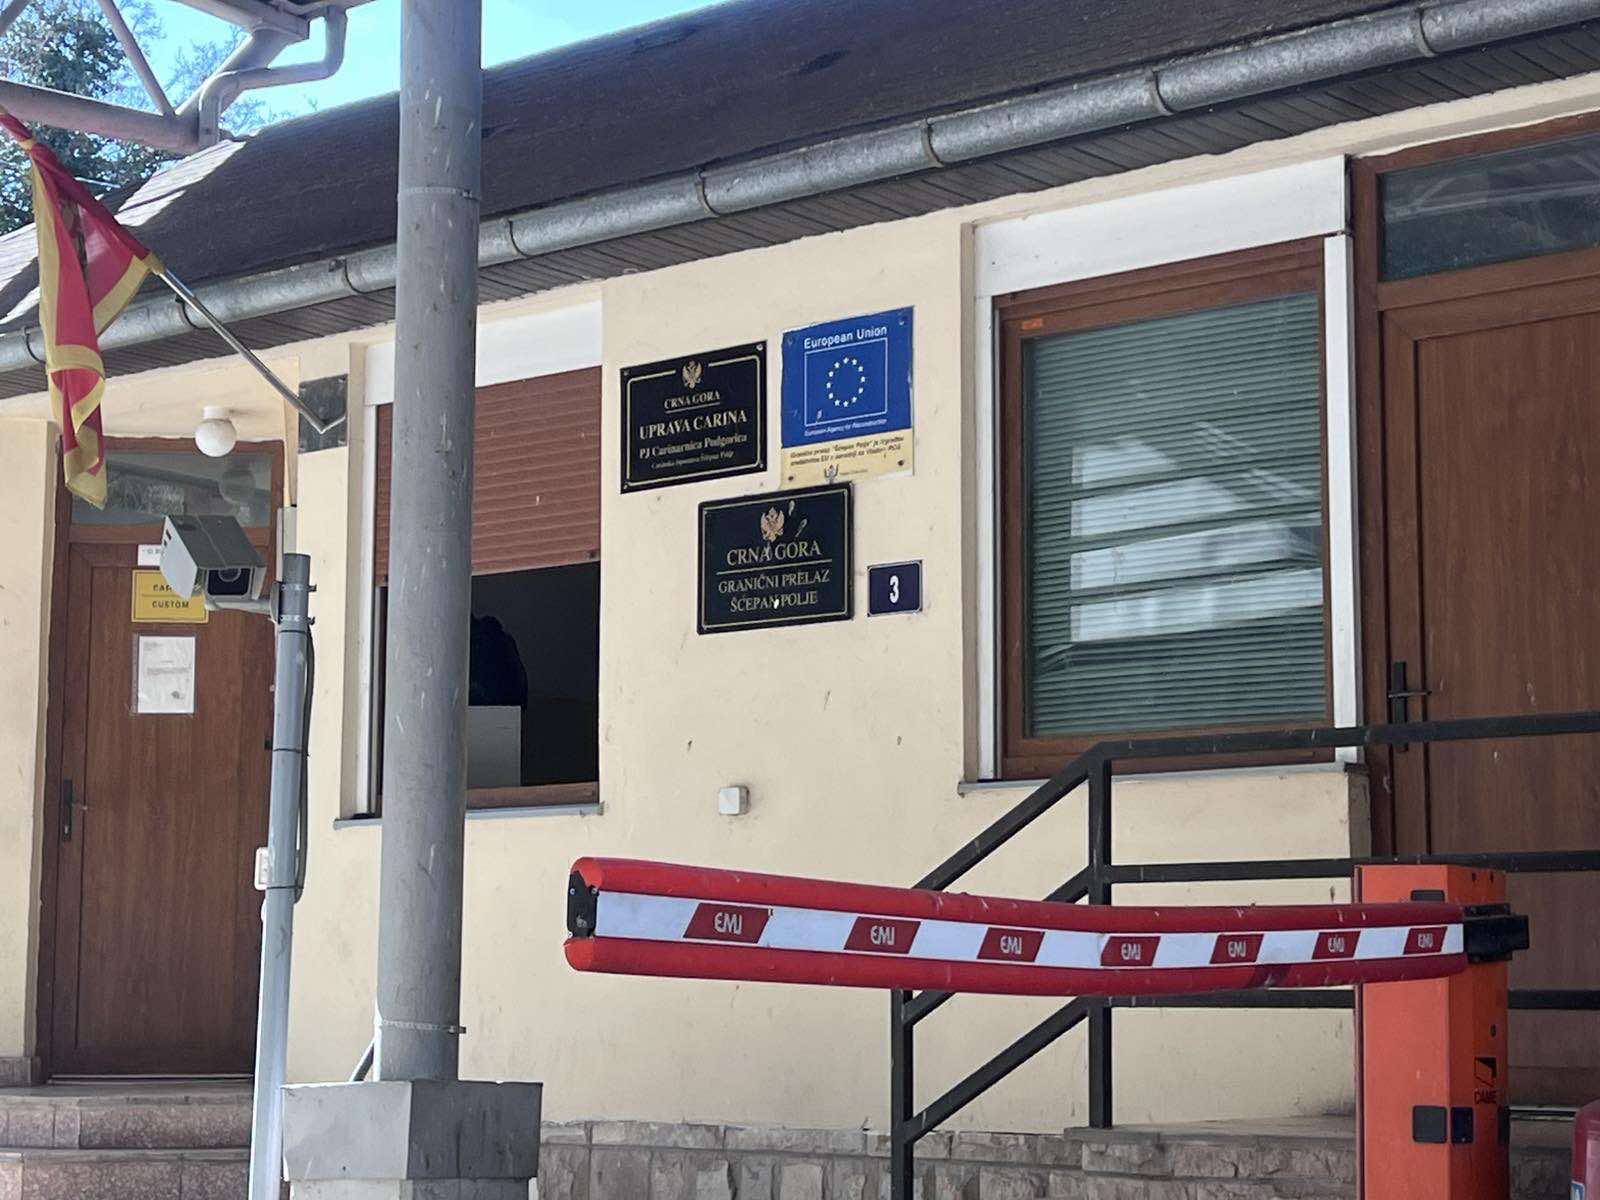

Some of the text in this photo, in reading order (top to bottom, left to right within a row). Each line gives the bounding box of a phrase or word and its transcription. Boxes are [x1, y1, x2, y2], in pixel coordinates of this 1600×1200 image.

[804, 326, 888, 349] European Union
[664, 389, 720, 409] CRNA GORA
[639, 410, 747, 440] UPRAVA CARINA
[639, 448, 650, 459] PJ
[726, 540, 822, 566] CRNA GORA
[718, 568, 830, 594] GRANIČNI PRELAZ
[890, 575, 899, 603] 3
[152, 600, 190, 609] CUSTOM
[780, 590, 818, 608] POLJE
